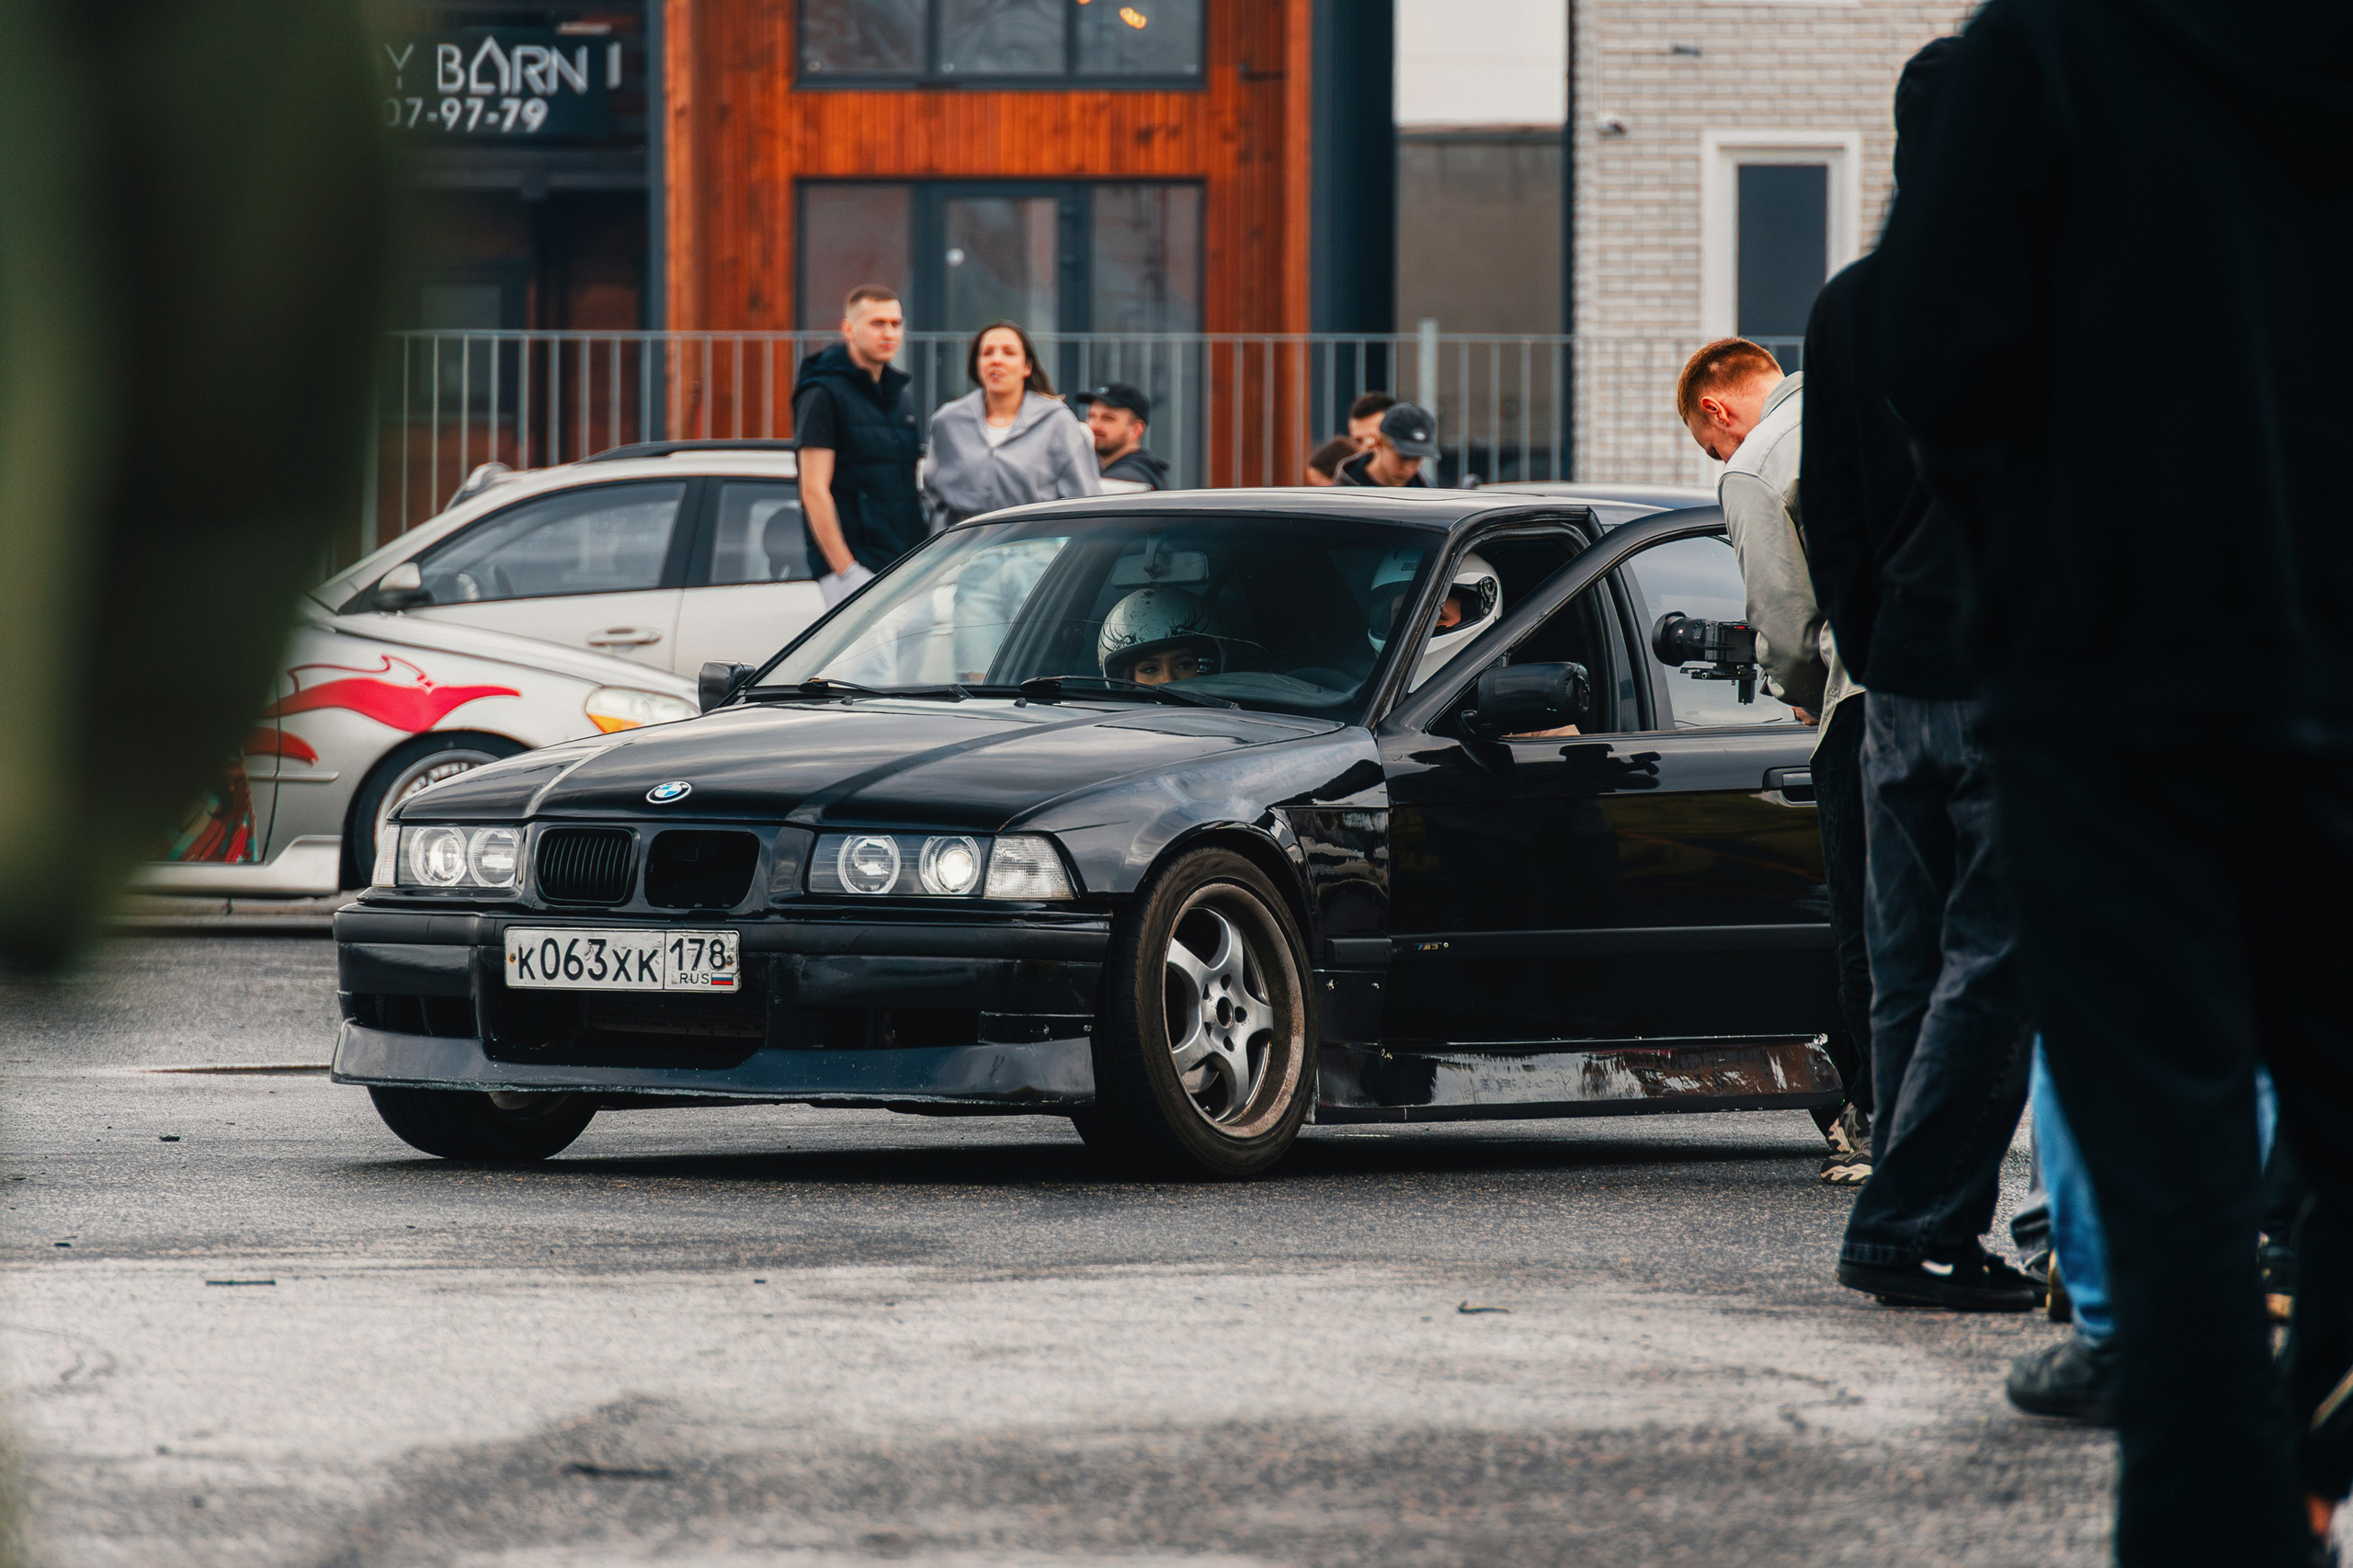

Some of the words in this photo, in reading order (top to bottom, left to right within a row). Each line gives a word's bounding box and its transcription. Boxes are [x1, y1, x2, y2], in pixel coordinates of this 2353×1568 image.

[437, 36, 588, 94] BARN
[668, 937, 727, 971] 178
[679, 972, 710, 984] RUS
